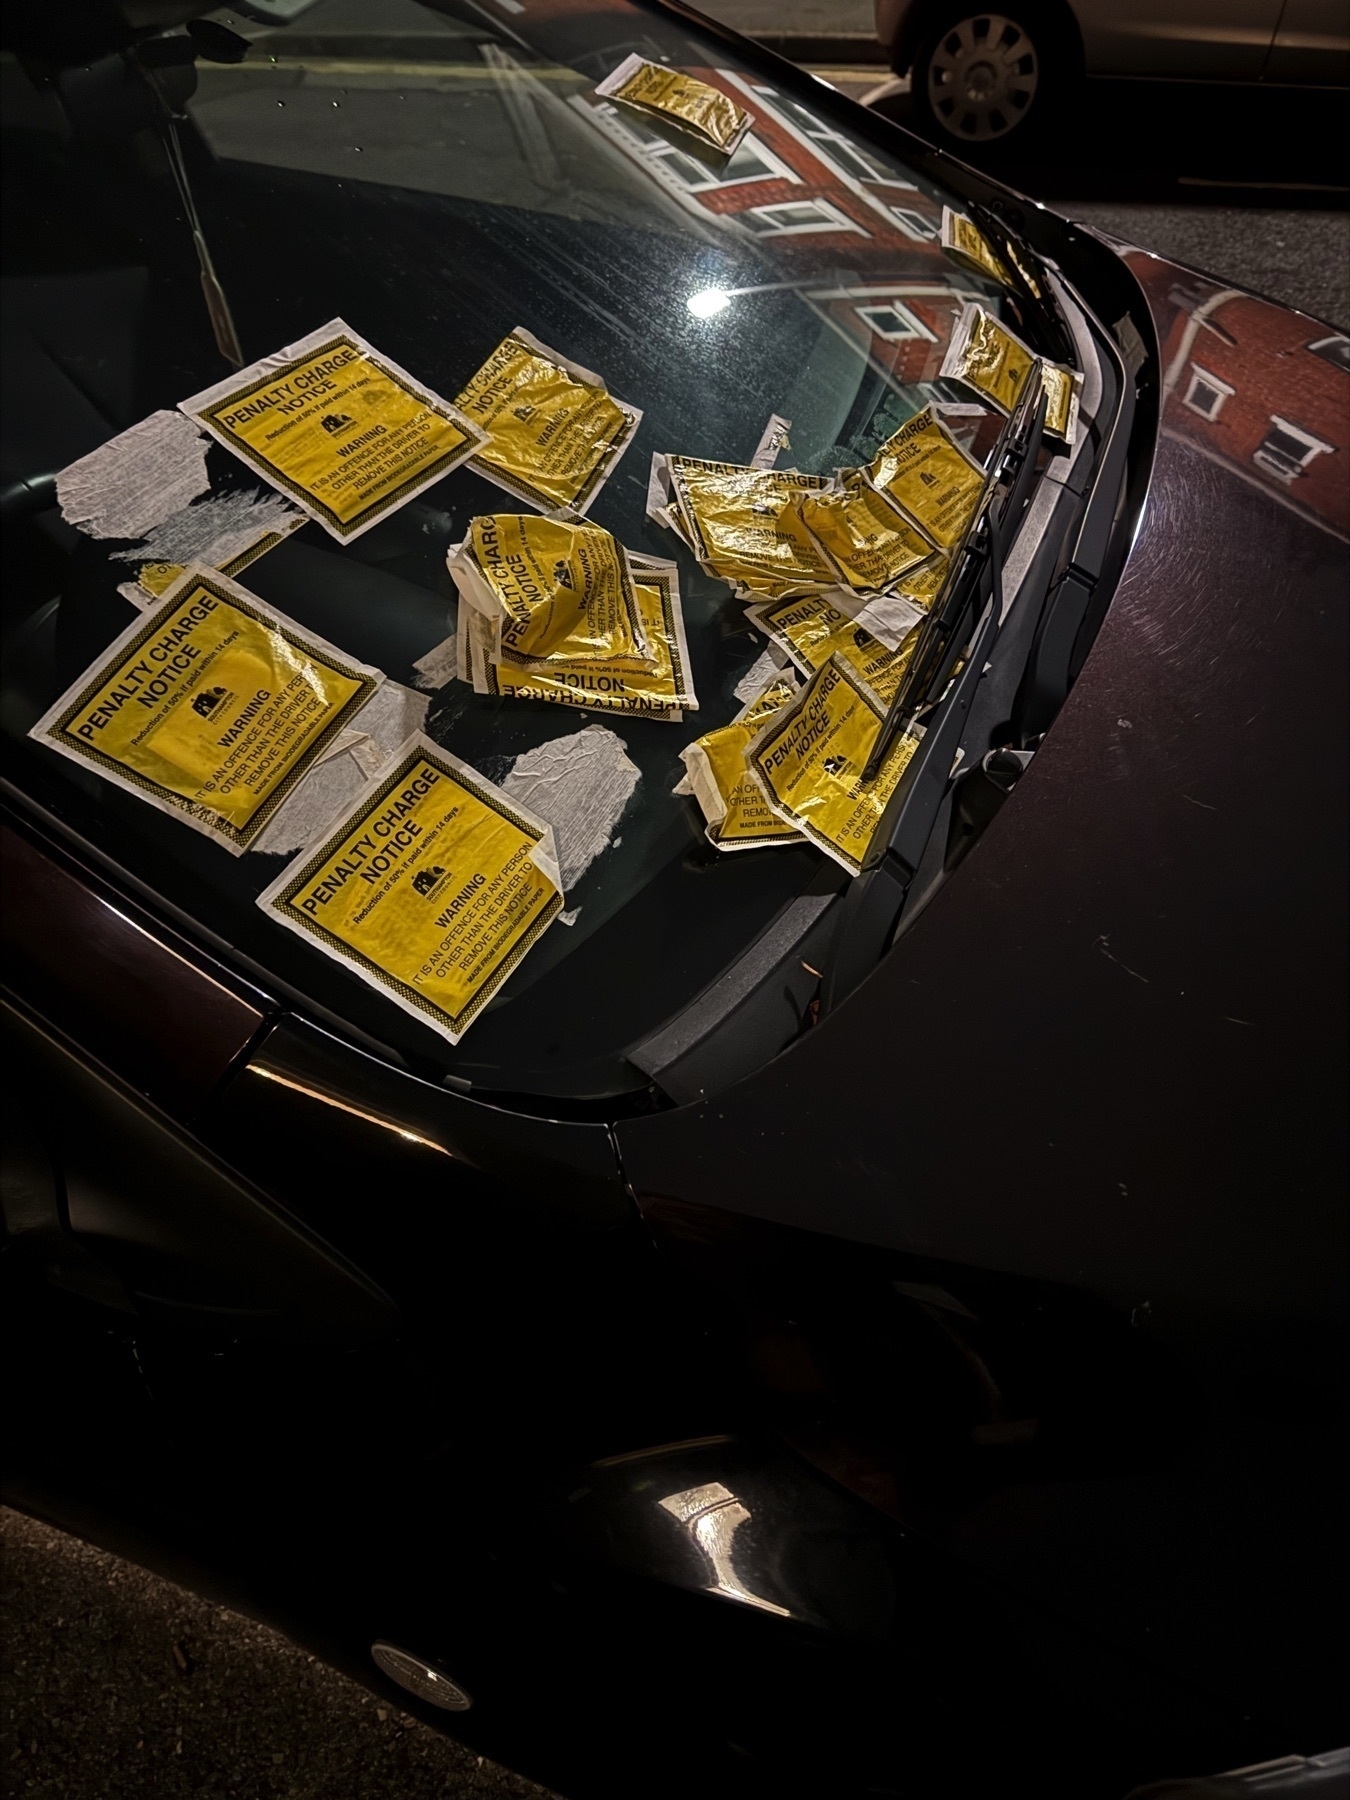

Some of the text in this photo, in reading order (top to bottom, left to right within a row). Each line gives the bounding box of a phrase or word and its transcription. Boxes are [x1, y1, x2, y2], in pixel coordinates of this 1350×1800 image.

[223, 350, 358, 429] PENALTY CHARGE
[265, 420, 298, 441] Reduction
[319, 397, 334, 409] paid
[332, 389, 350, 401] within
[276, 379, 337, 416] NOTICE
[472, 377, 513, 414] NOTICE
[332, 423, 431, 490] OTHER THAN THE DRIVER TO
[336, 425, 388, 458] WARNING
[536, 408, 570, 446] WARNING
[558, 431, 581, 459] THAN THE
[894, 415, 934, 447] CHARGE
[896, 443, 921, 465] OTICE
[309, 482, 322, 491] IT
[318, 478, 330, 486] IS
[327, 470, 341, 481] AN
[338, 448, 375, 473] OFFENCE
[372, 437, 391, 451] FOR
[388, 428, 404, 441] ANY
[352, 437, 430, 490] REMOVE THIS NOTICE
[561, 450, 582, 475] REMOVE
[480, 516, 532, 647] PENALTY CHARG
[506, 554, 544, 603] NOTICE
[578, 549, 593, 610] WARNING
[592, 561, 600, 581] FOR
[588, 581, 599, 628] OFFENCE
[607, 573, 616, 635] REMOVE THIS
[776, 599, 830, 630] PENALT
[77, 595, 219, 741] PENALTY CHARGE
[130, 630, 240, 747] Reduction of 50% if paid within 14 days
[137, 644, 202, 709] NOTICE
[554, 672, 626, 693] NOTICE
[194, 689, 291, 802] IT IS AN OFFENCE FOR ANY
[217, 690, 272, 748] WARNING
[220, 690, 311, 794] OTHER THAN THE DRIVER
[243, 697, 322, 787] REMOVE THIS NOTICE
[764, 720, 809, 775] PENALTY
[802, 668, 841, 722] CHARGE
[796, 710, 830, 761] NOTICE
[253, 778, 270, 795] MADE
[267, 762, 285, 779] FROM
[282, 715, 321, 763] BIODEGRADABLE
[786, 768, 806, 792] Reduction
[804, 761, 810, 770] of
[819, 737, 830, 752] paid
[827, 723, 842, 740] within
[839, 716, 848, 724] 14
[730, 795, 758, 807] OTHER
[836, 763, 894, 844] IT IS AN FOR ANY
[847, 780, 869, 801] WARN
[853, 814, 874, 840] OTHER
[881, 785, 893, 800] THE
[891, 762, 907, 786] DRIVER
[904, 751, 913, 763] TO
[301, 768, 441, 916] PENALTY CHARGE
[353, 807, 459, 925] Reduction of 50% if paid within 14 days
[360, 819, 423, 885] NOTICE
[412, 842, 533, 986] IT IS AN OFFENCE FOR ANY PERSON
[426, 872, 453, 902] SOUTHAMPTON
[435, 874, 487, 928] WARNING
[436, 862, 533, 978] OTHER THAN THE DRIVER TO
[458, 882, 533, 971] REMOVE THIS NOTICE
[467, 888, 545, 984] MADE FROM BIODEGRADABLE PAPER
